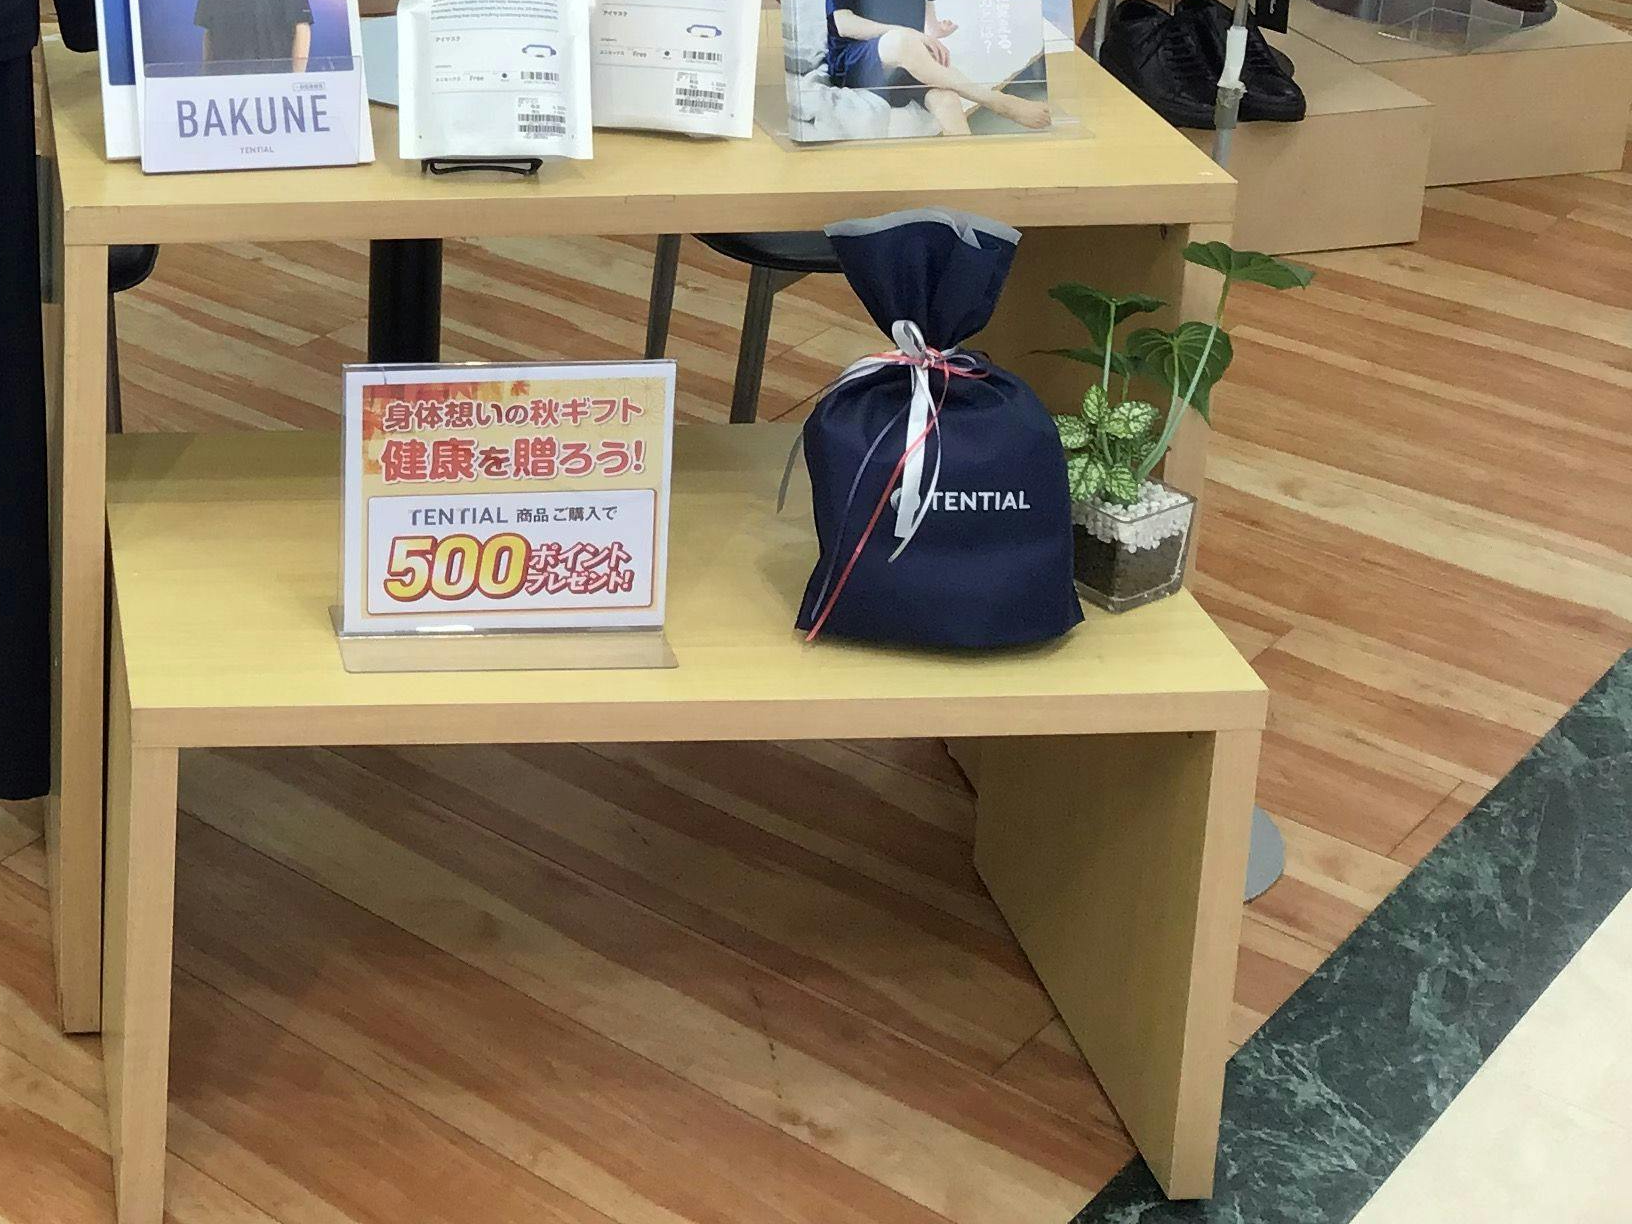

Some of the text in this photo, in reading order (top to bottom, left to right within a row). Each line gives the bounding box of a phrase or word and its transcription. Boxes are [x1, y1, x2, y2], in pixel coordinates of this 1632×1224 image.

[176, 94, 331, 139] BAKUNE
[240, 145, 275, 155] TENTIAL
[383, 396, 643, 431] 身体想いの秋ギフト
[931, 490, 1031, 511] TENTIAL
[409, 507, 509, 526] TENTIAL
[383, 532, 531, 602] 500
